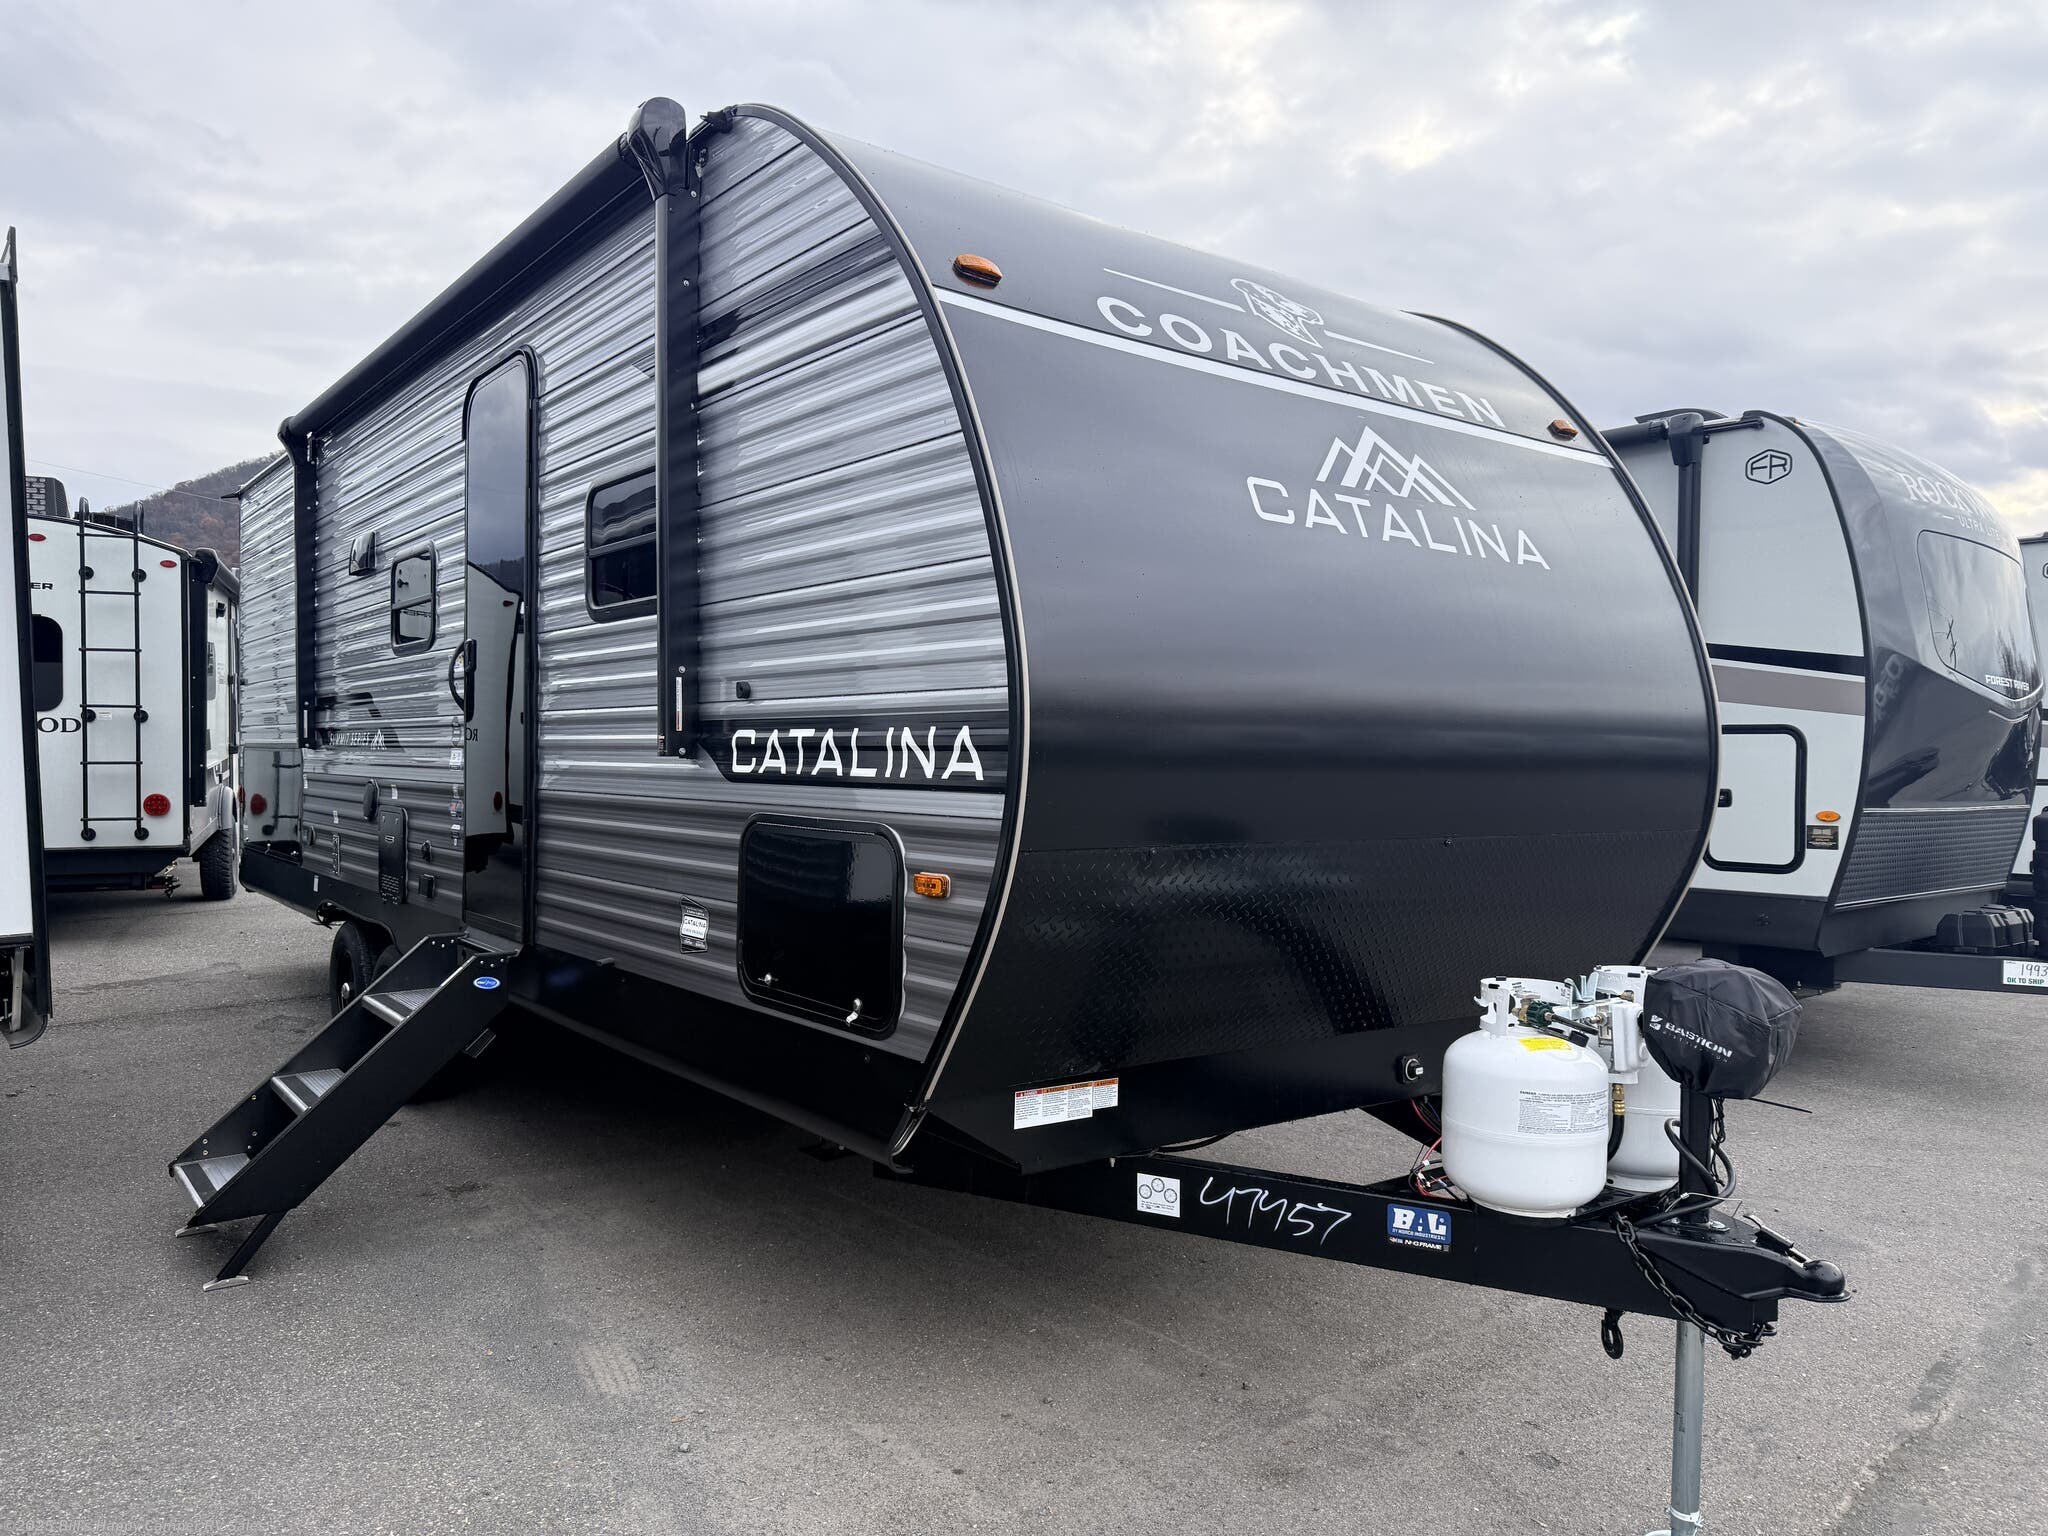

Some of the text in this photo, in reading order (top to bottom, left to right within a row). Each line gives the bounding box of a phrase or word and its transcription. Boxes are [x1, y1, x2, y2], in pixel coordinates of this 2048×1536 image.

[1096, 296, 1506, 428] COACHMEN
[1246, 476, 1551, 570] CATALINA
[1985, 674, 2030, 691] FOREST RIVER
[37, 717, 82, 733] OD
[350, 732, 370, 746] SERIES
[731, 725, 984, 781] CATALINA
[1665, 1022, 1732, 1057] BASTION
[1392, 1207, 1447, 1235] BAL
